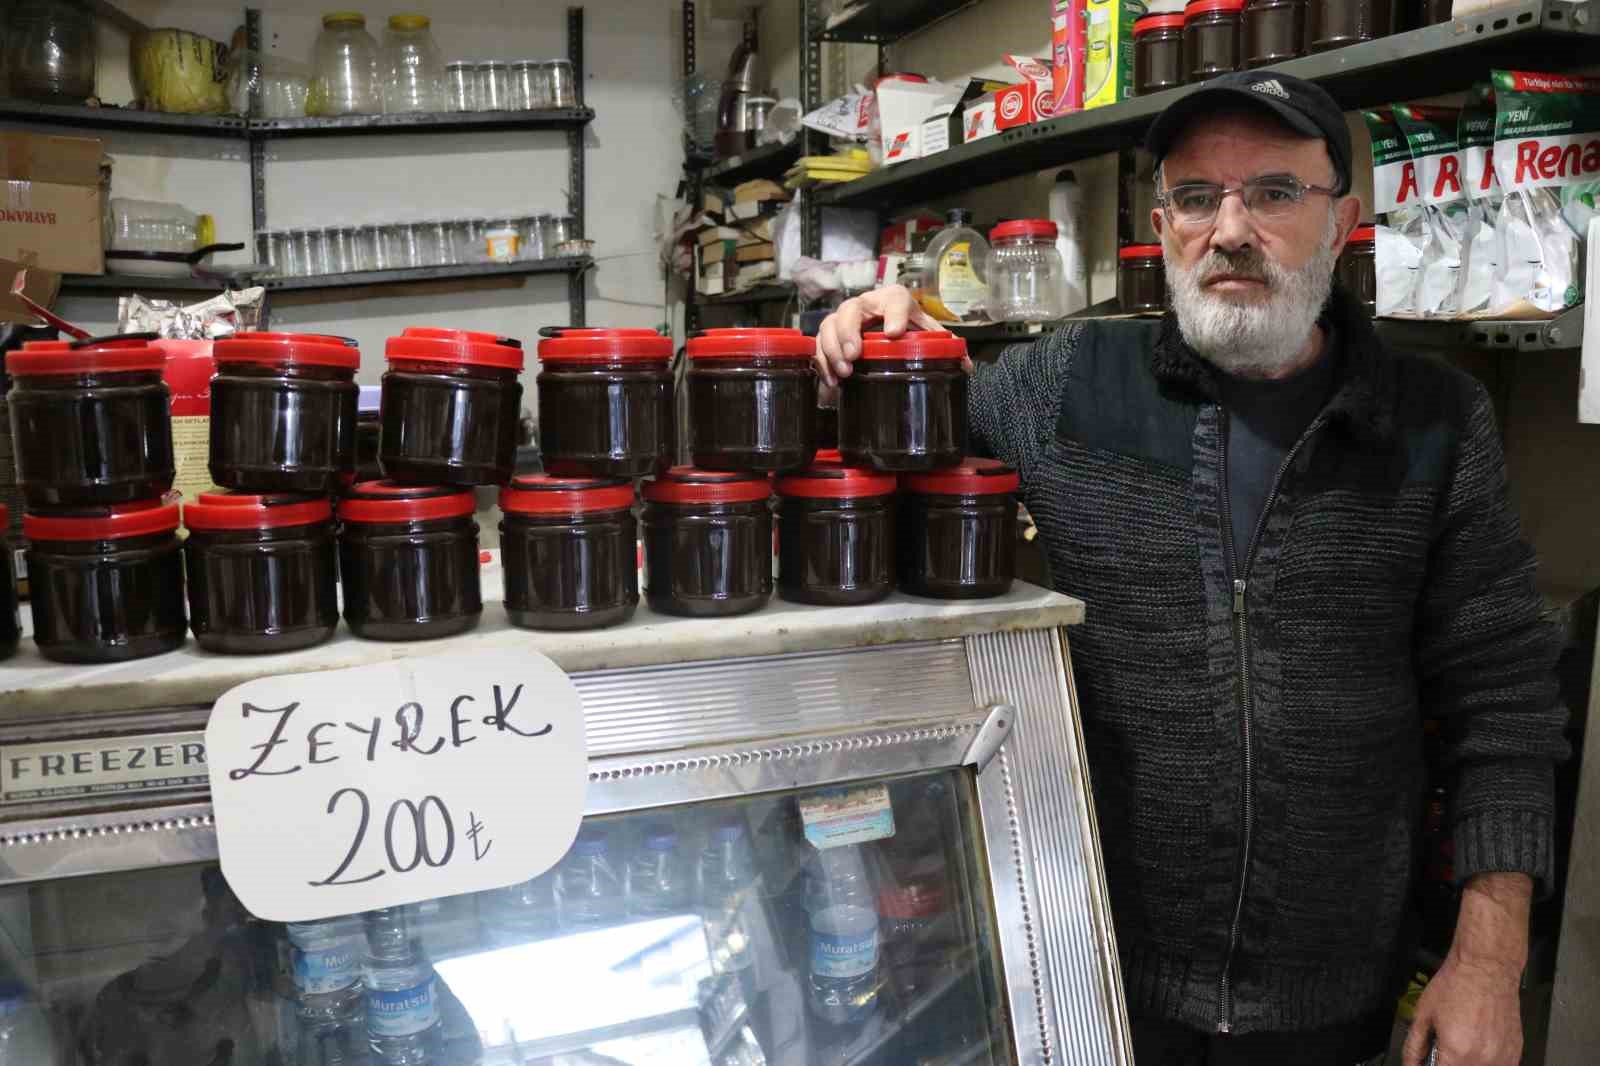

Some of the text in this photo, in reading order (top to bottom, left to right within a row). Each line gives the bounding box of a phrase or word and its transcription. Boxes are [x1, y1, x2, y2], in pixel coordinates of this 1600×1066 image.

[1251, 83, 1290, 99] adidas
[229, 684, 553, 780] ZEYREK
[10, 742, 206, 780] FREEZER
